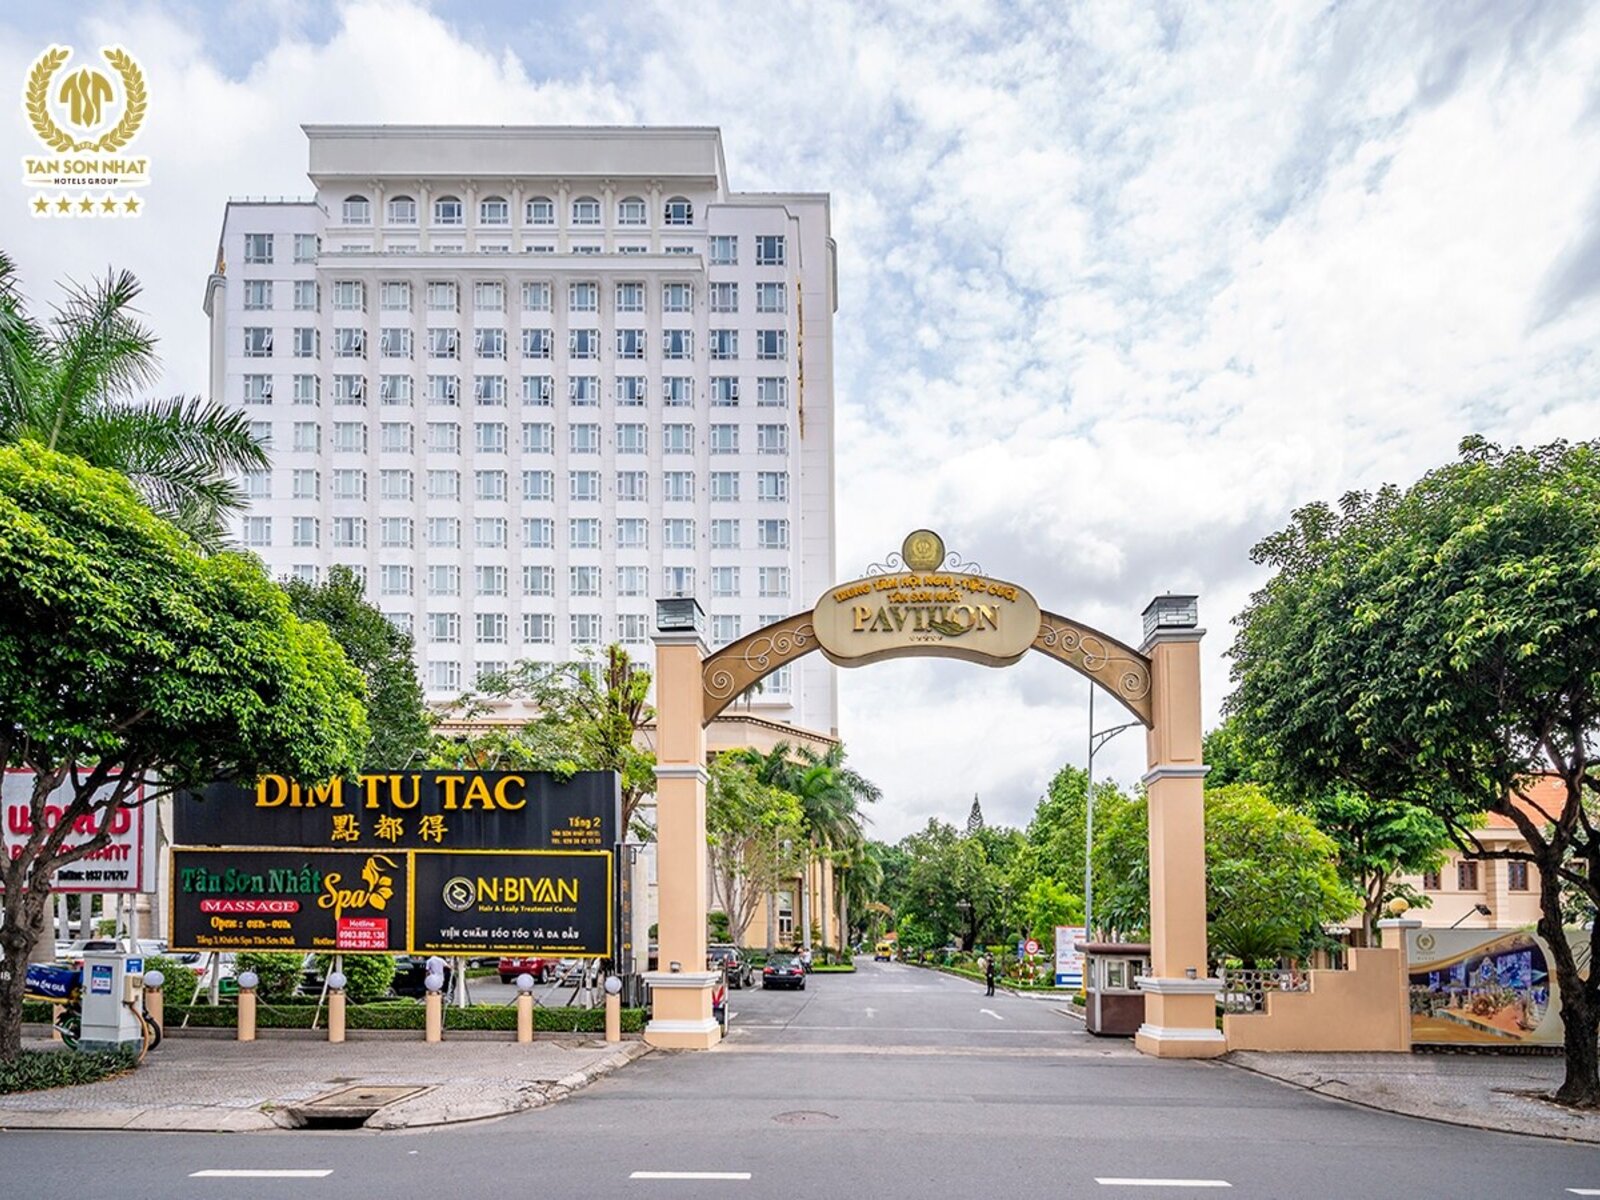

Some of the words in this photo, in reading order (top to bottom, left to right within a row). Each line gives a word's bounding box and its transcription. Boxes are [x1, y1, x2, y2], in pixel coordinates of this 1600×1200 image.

[852, 604, 1000, 636] PAVILION
[356, 774, 421, 809] TU
[435, 775, 526, 810] TAC
[331, 814, 448, 843] 點都得
[593, 816, 601, 828] 2
[224, 867, 265, 893] Sơn
[268, 863, 321, 893] Nhất
[205, 901, 295, 912] MASSAGE
[318, 873, 370, 921] Spa
[502, 906, 519, 914] Scalp
[350, 920, 376, 928] Hotline
